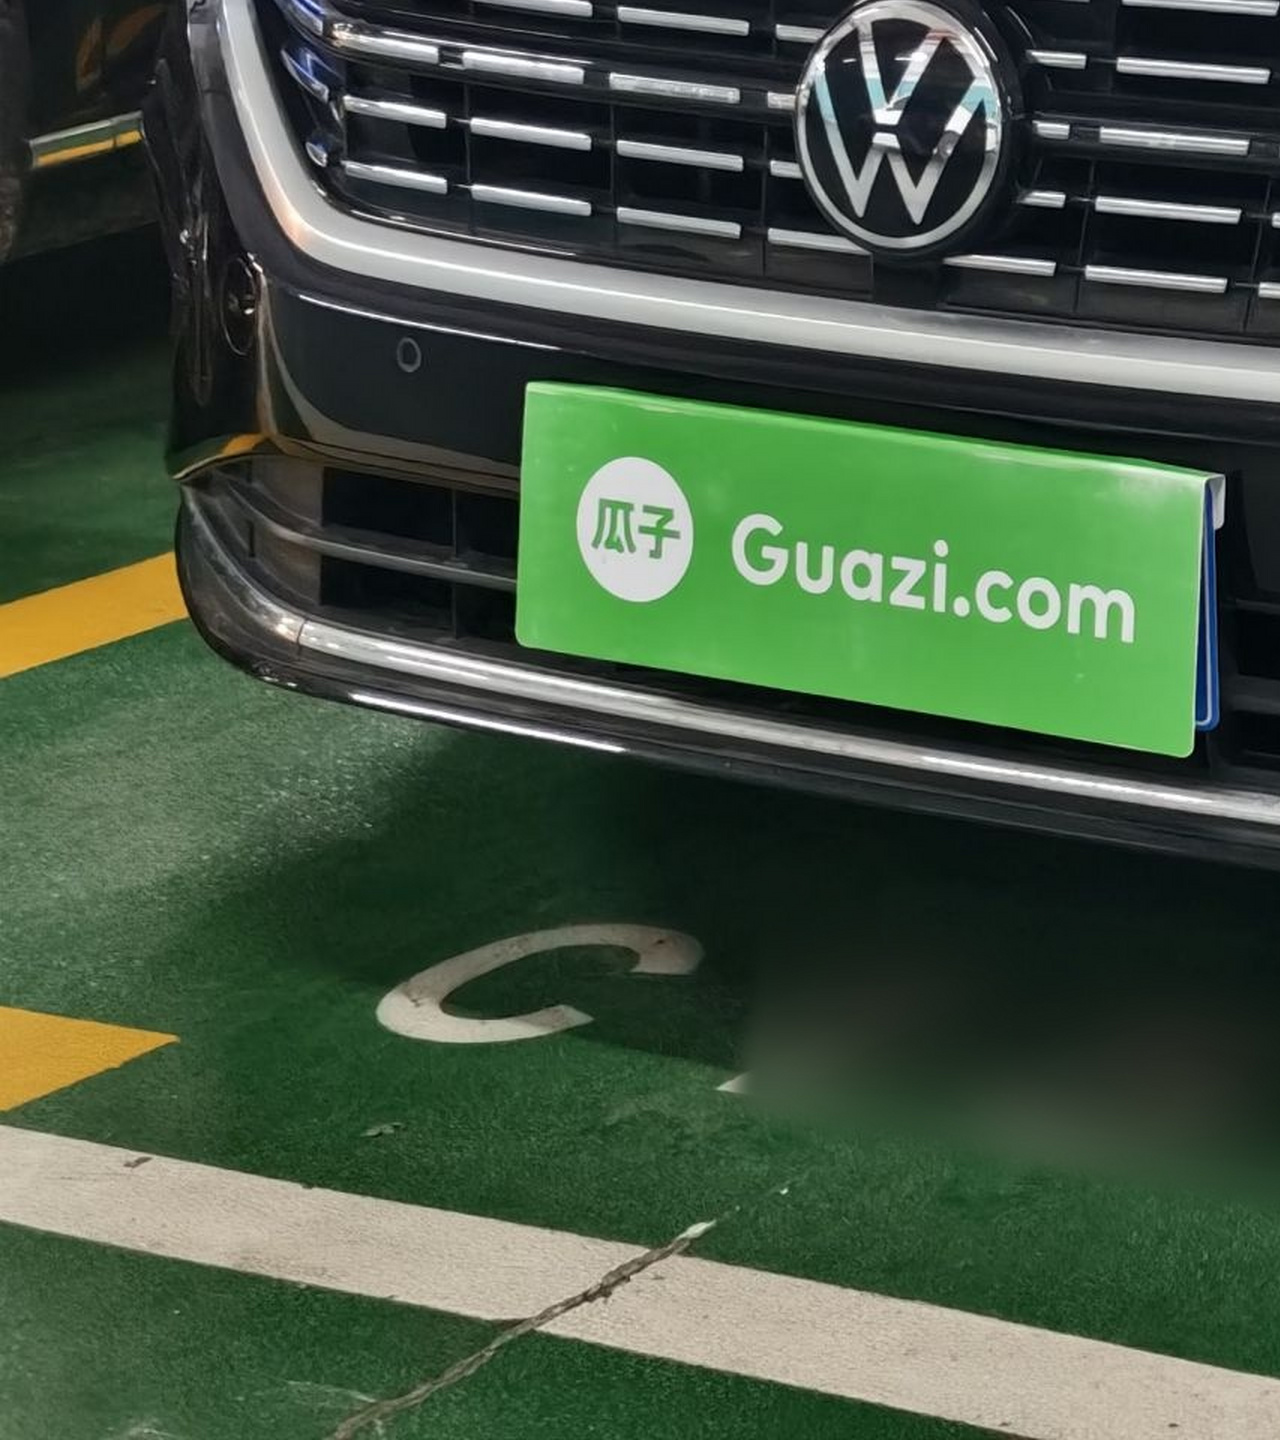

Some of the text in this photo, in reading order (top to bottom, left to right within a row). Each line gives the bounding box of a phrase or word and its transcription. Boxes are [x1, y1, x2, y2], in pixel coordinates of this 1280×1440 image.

[811, 12, 999, 225] VW
[591, 497, 682, 559] 瓜子
[731, 513, 1136, 644] Guazi.com
[376, 923, 704, 1043] C
